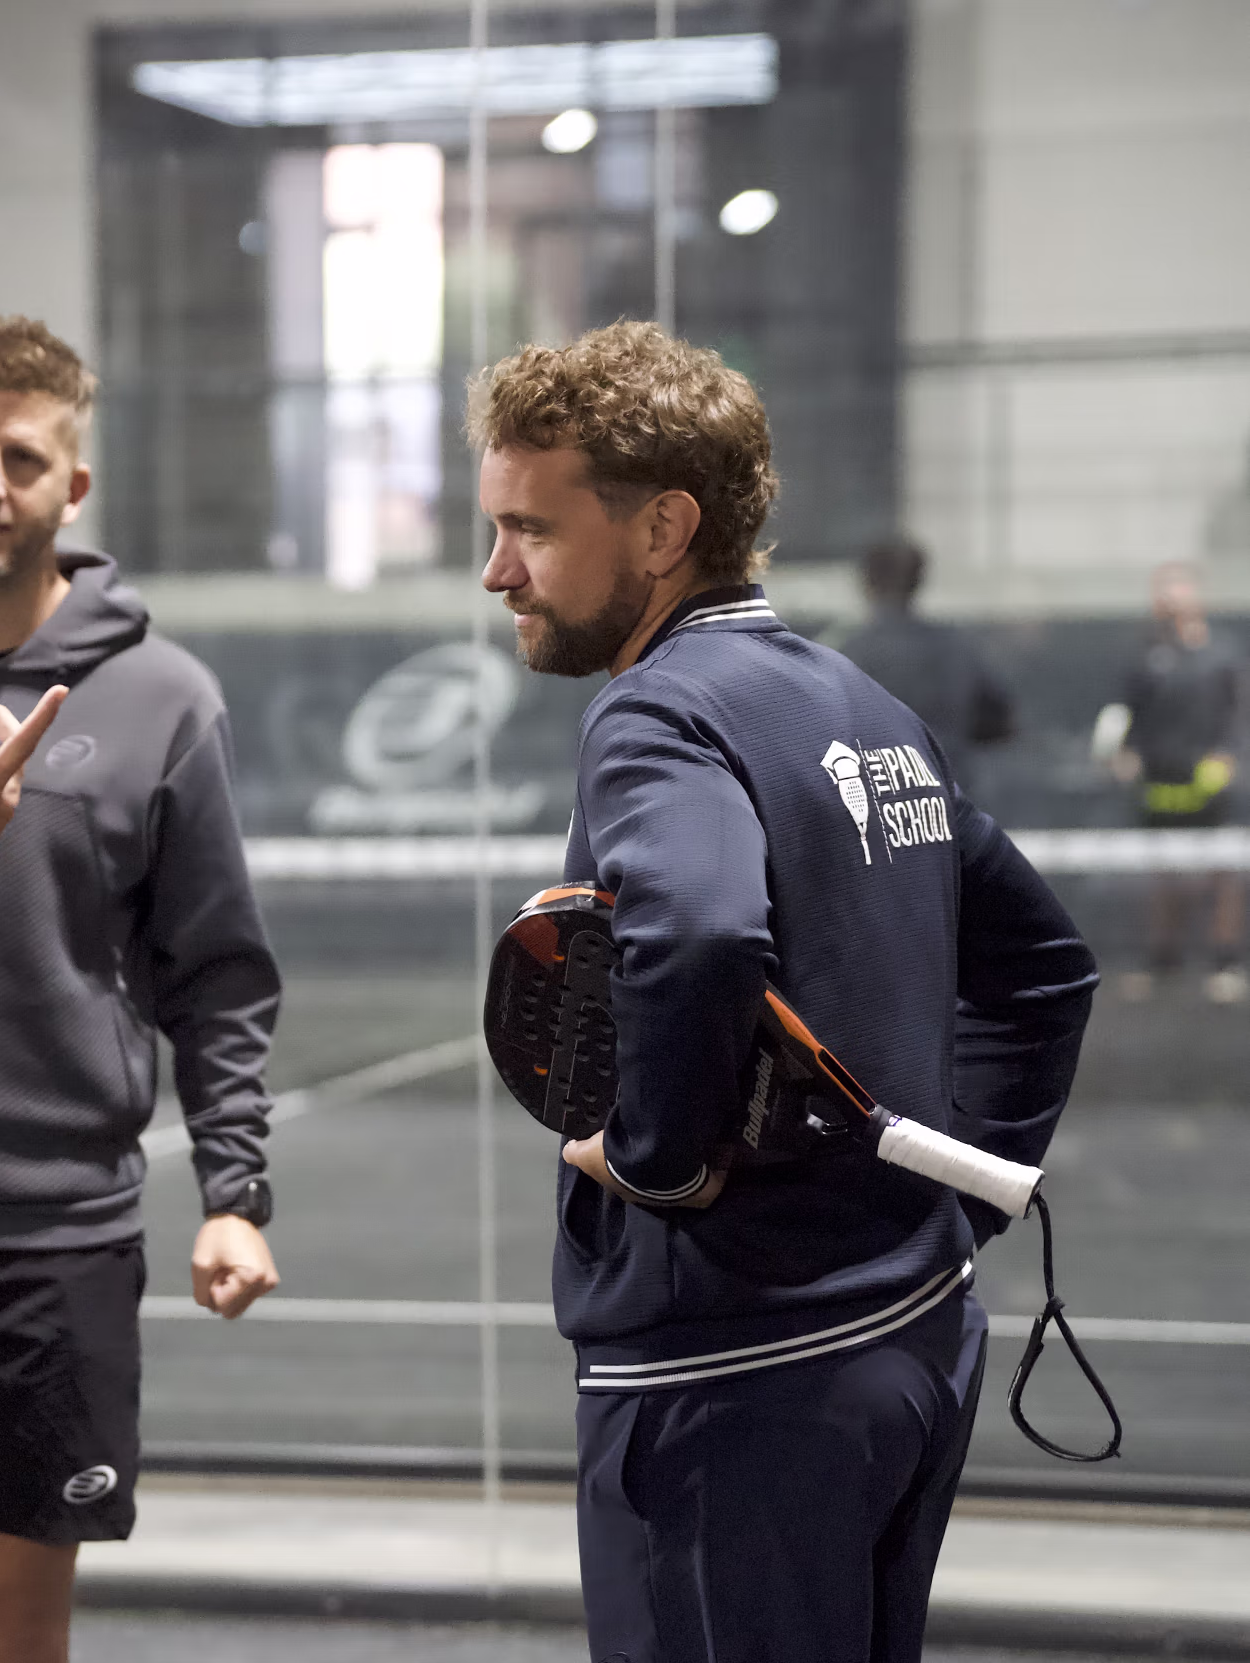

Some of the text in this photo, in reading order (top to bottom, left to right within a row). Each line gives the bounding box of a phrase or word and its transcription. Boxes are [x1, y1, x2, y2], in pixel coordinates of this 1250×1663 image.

[864, 749, 891, 797] THE
[882, 797, 953, 848] SCHOOL
[742, 1046, 775, 1150] Bullpadel
